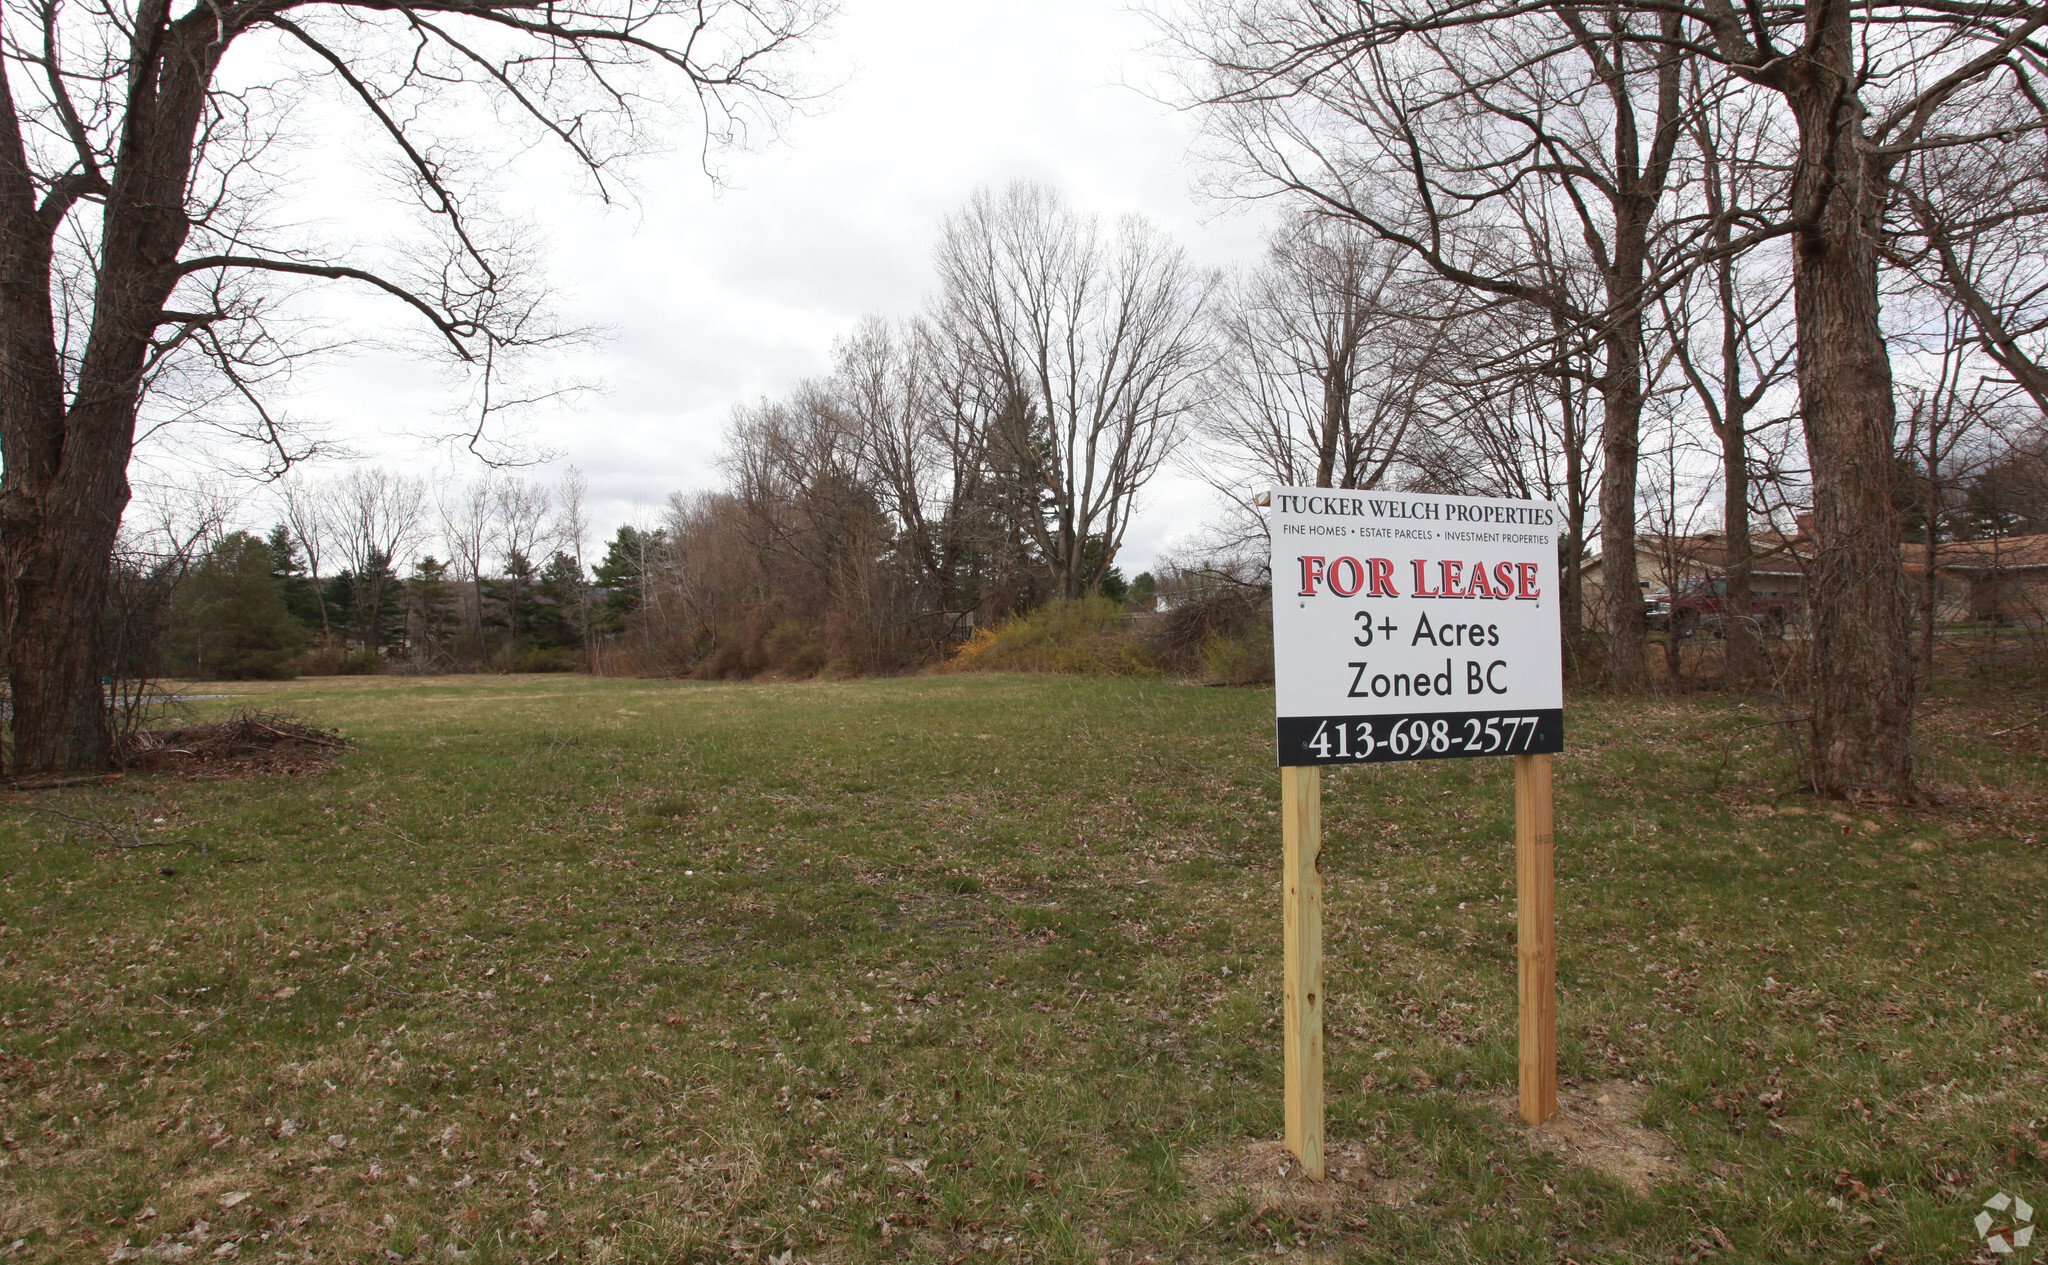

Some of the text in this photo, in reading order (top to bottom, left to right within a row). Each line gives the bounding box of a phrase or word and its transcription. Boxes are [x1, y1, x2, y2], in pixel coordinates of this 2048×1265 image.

[1278, 494, 1553, 526] TUCKER WELCH PROPERTIES
[1283, 524, 1549, 545] FINE HOMES ESTATE PARCELS INVESTMENT PROPERTIES
[1297, 555, 1541, 601] FOR LEASE
[1353, 610, 1500, 647] 3+ Acres
[1347, 658, 1508, 698] Zoned BC
[1308, 716, 1539, 759] 413-698-2577
